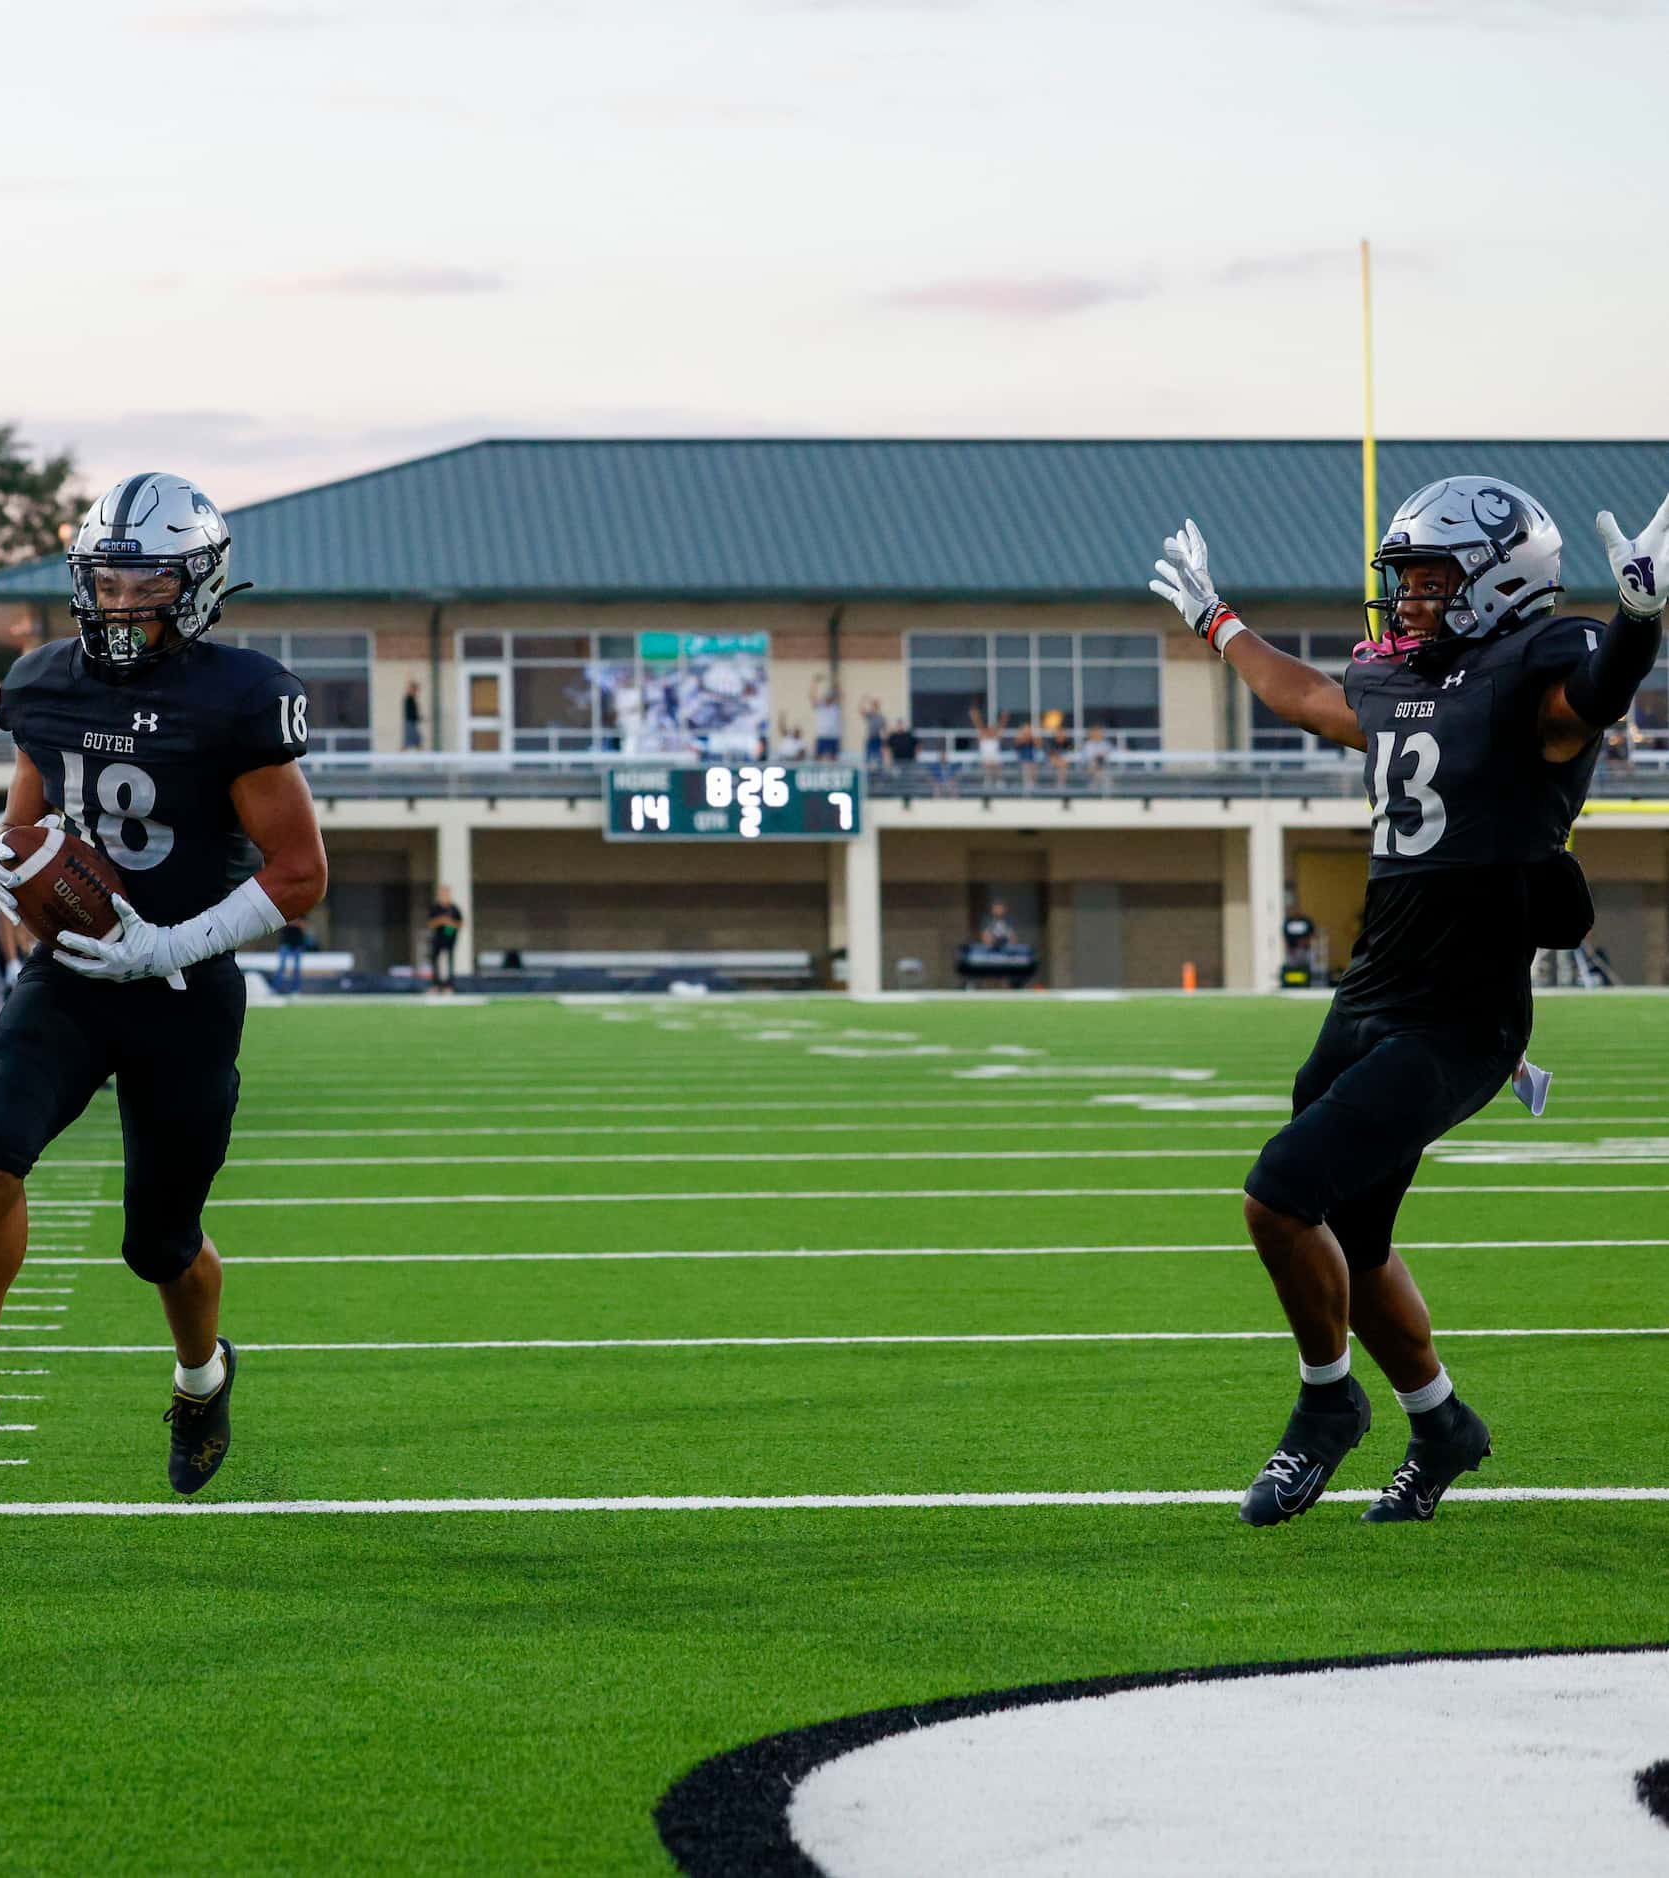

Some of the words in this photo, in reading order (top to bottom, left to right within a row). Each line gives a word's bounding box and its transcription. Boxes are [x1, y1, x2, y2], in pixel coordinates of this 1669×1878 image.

[98, 541, 136, 552] WILDCATS
[278, 693, 309, 745] 18
[1394, 701, 1436, 718] GUYER
[83, 731, 135, 754] GUYER
[60, 751, 175, 871] 18
[631, 794, 670, 831] 14
[827, 792, 852, 830] 7
[1370, 731, 1447, 857] 13
[739, 806, 762, 838] 2
[53, 877, 93, 926] Wilson
